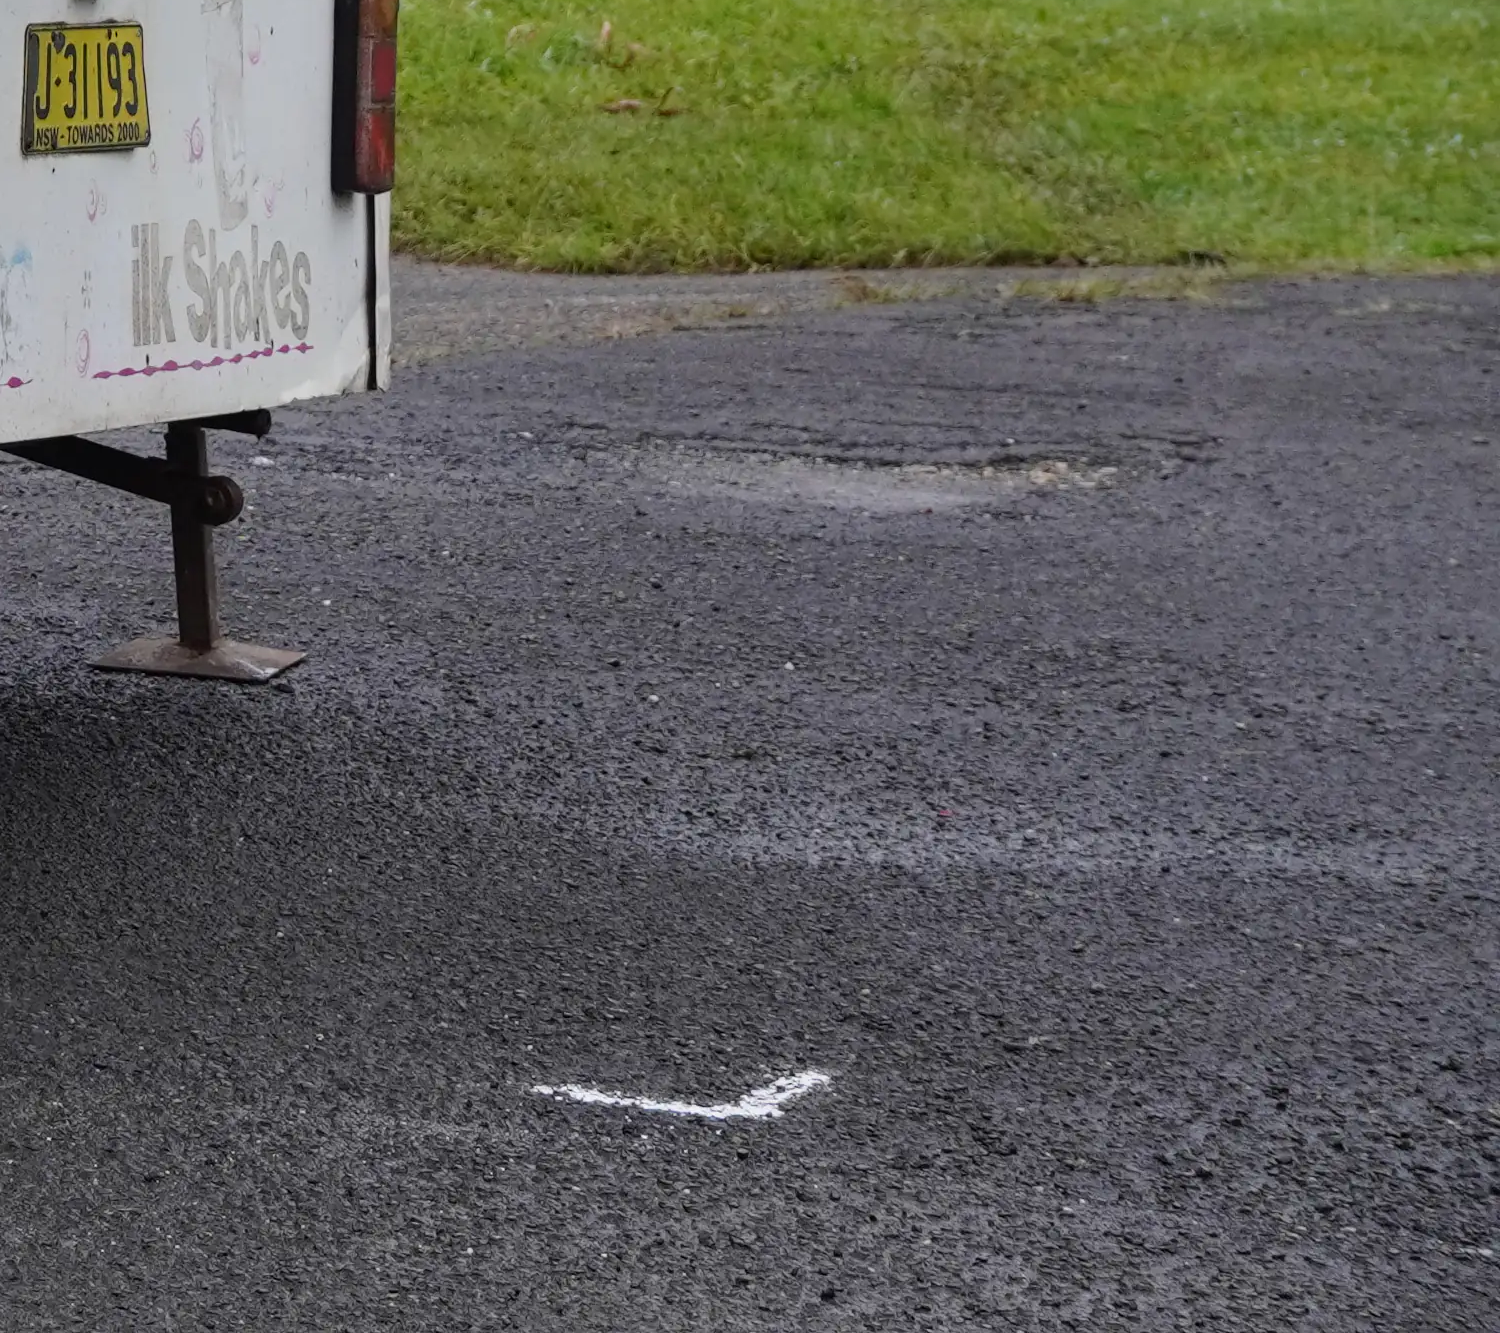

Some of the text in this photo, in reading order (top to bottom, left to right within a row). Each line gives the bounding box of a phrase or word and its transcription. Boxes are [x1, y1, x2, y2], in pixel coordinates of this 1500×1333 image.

[36, 122, 140, 147] NSW TOWARDS 2000
[184, 220, 313, 347] Shakes
